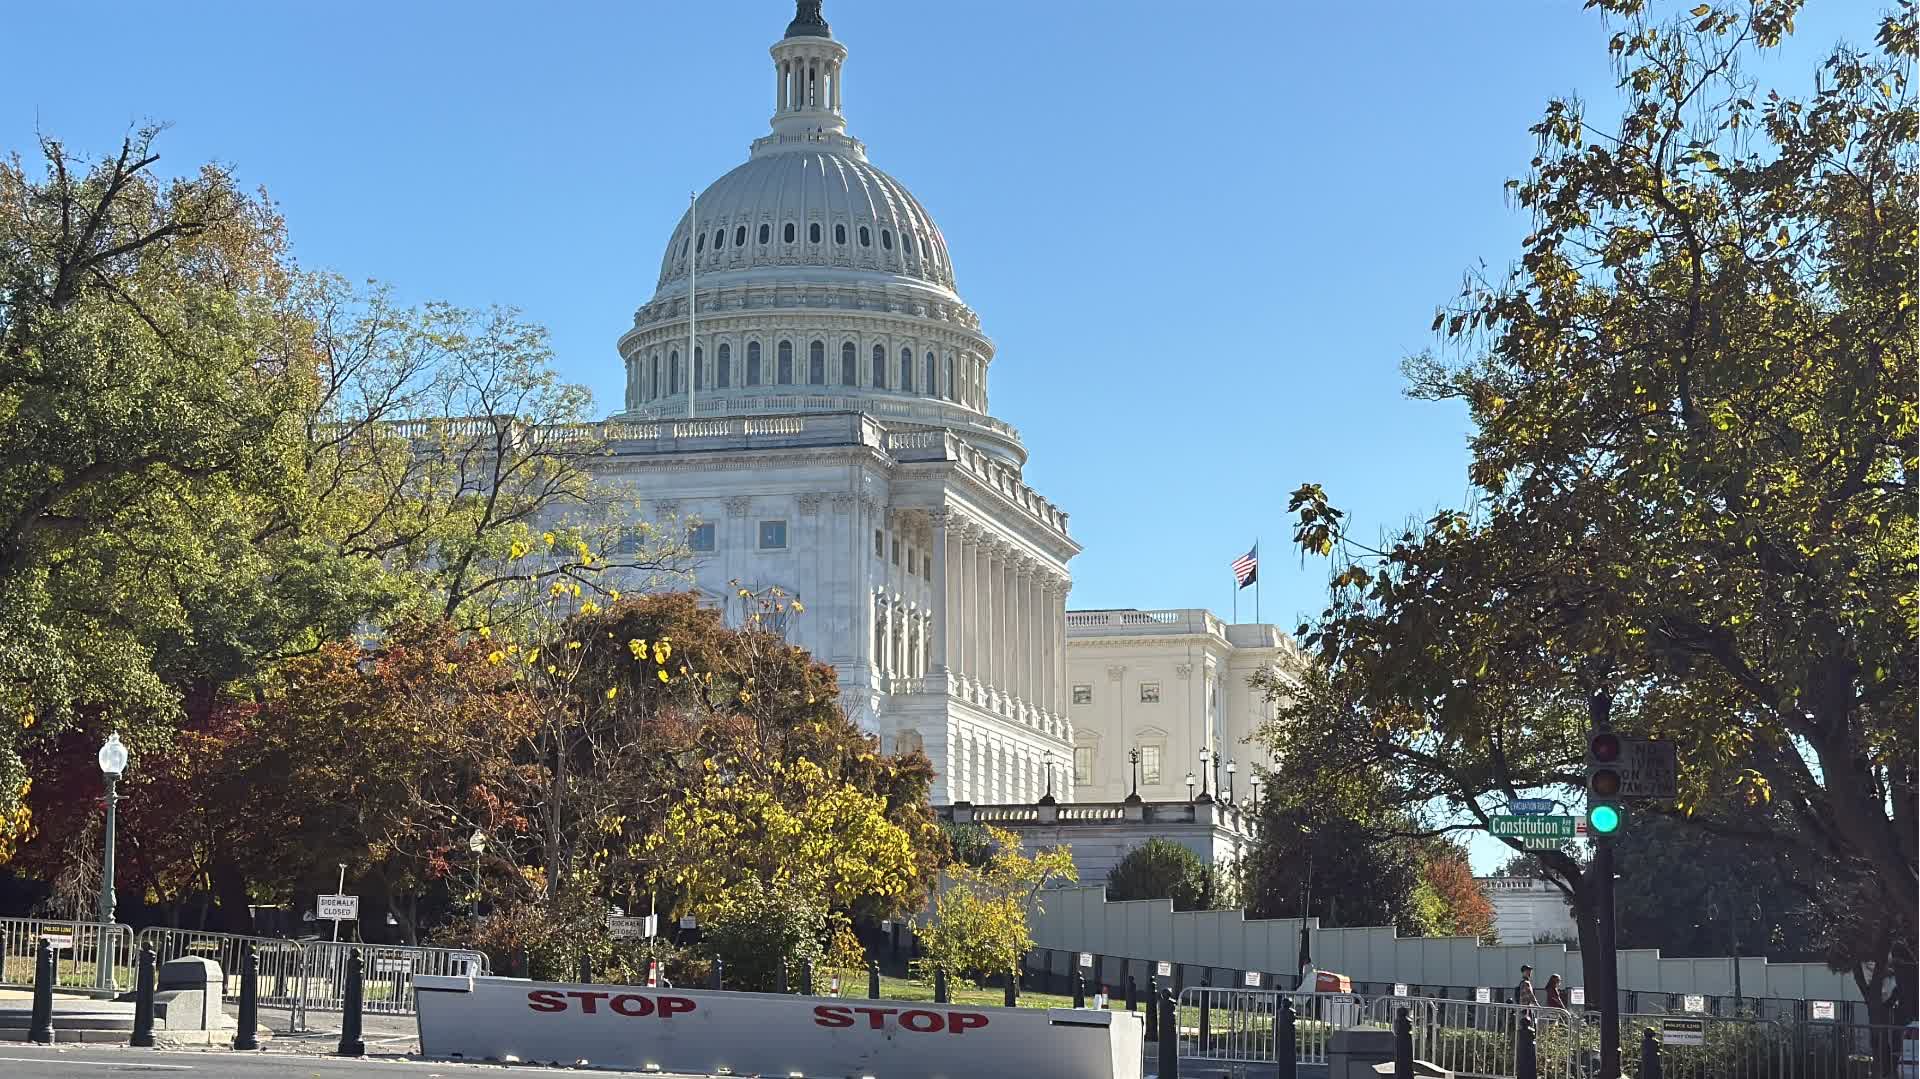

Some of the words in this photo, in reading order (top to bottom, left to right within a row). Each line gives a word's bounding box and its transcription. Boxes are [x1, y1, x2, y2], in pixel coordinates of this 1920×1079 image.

[1492, 817, 1558, 834] Constitution
[1525, 838, 1559, 849] UNIT
[321, 899, 355, 907] SIDEWALK
[323, 908, 351, 916] CLOSED
[527, 990, 697, 1018] STOP
[814, 1005, 989, 1034] STOP
